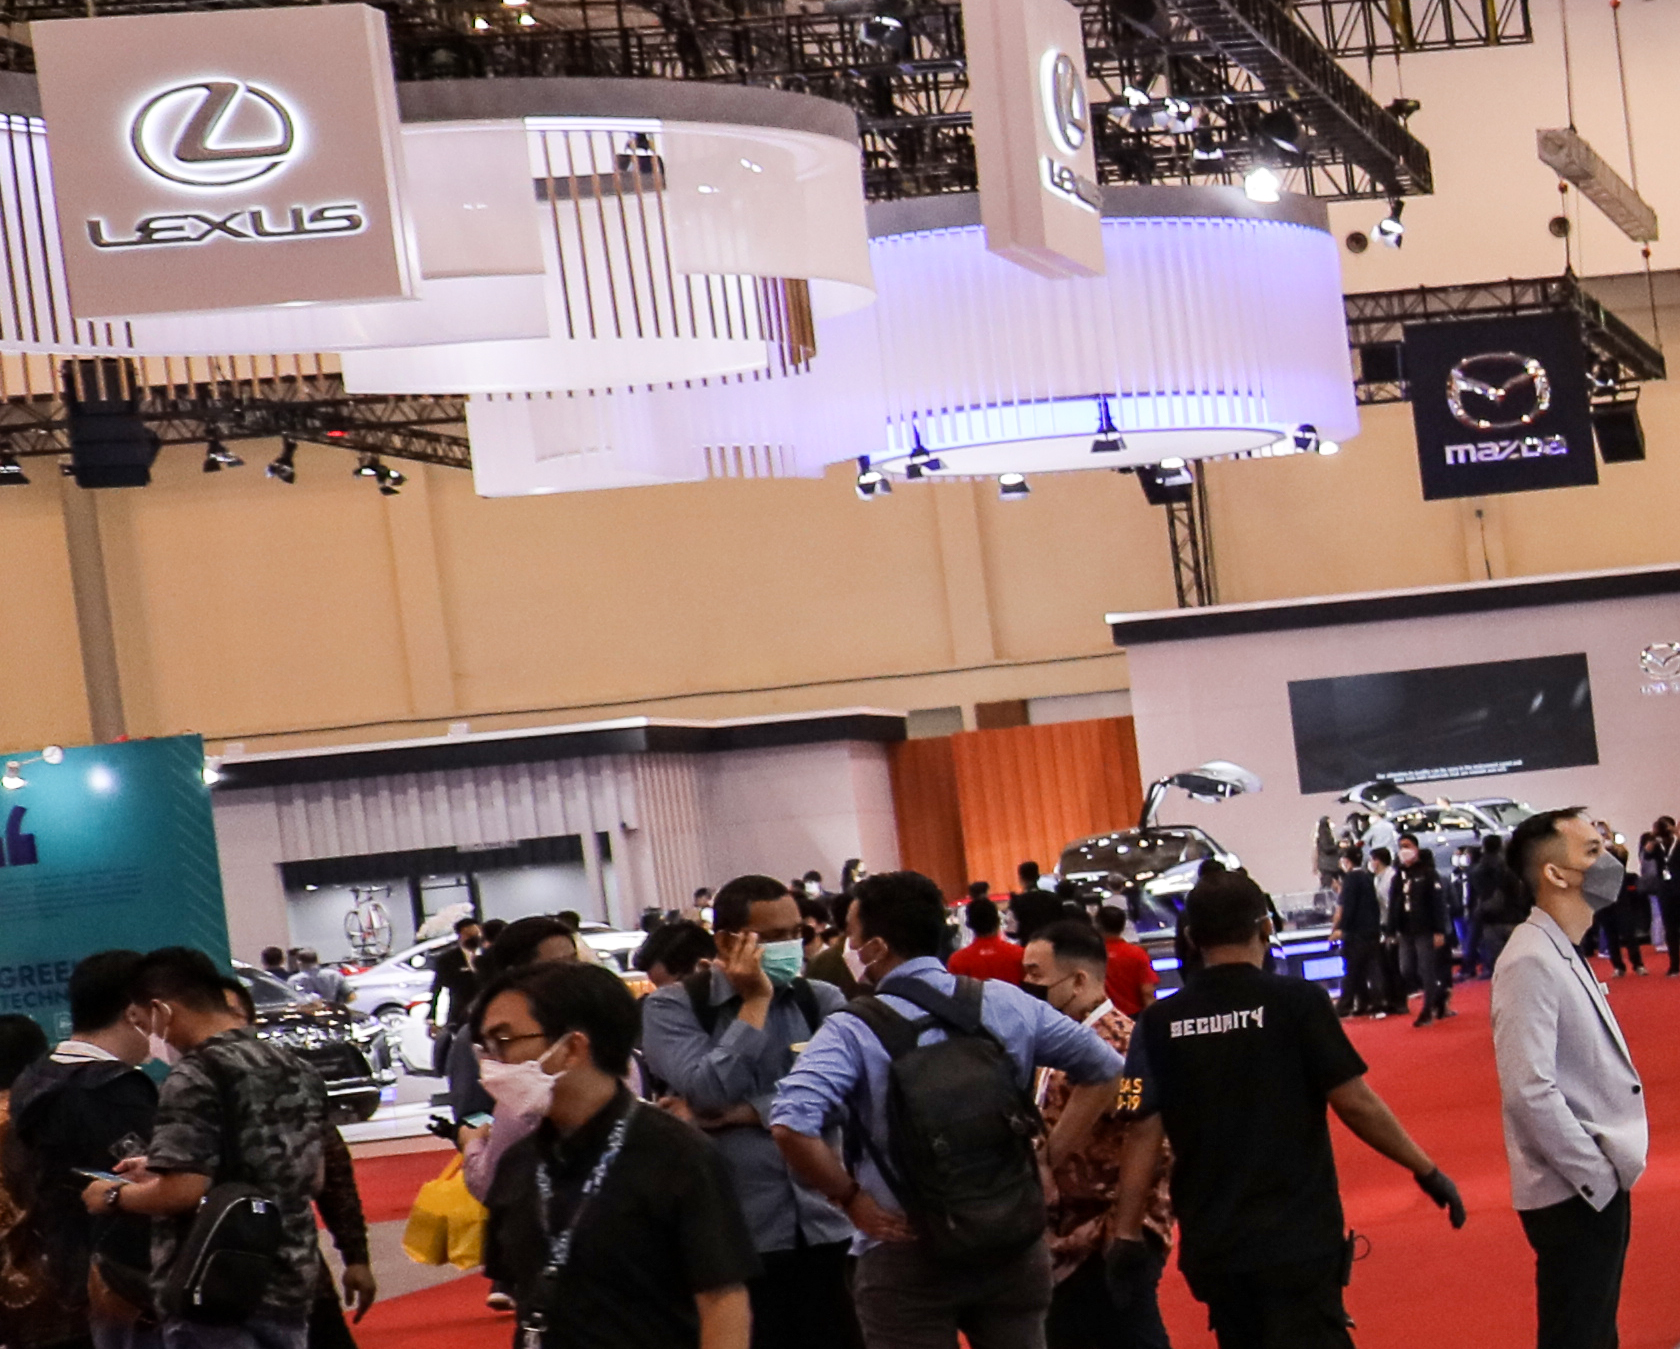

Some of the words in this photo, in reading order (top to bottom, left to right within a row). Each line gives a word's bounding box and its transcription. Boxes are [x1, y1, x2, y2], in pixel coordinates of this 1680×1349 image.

[86, 203, 364, 250] LEXUS
[0, 961, 80, 989] GREE
[1169, 1005, 1265, 1039] SECURITY
